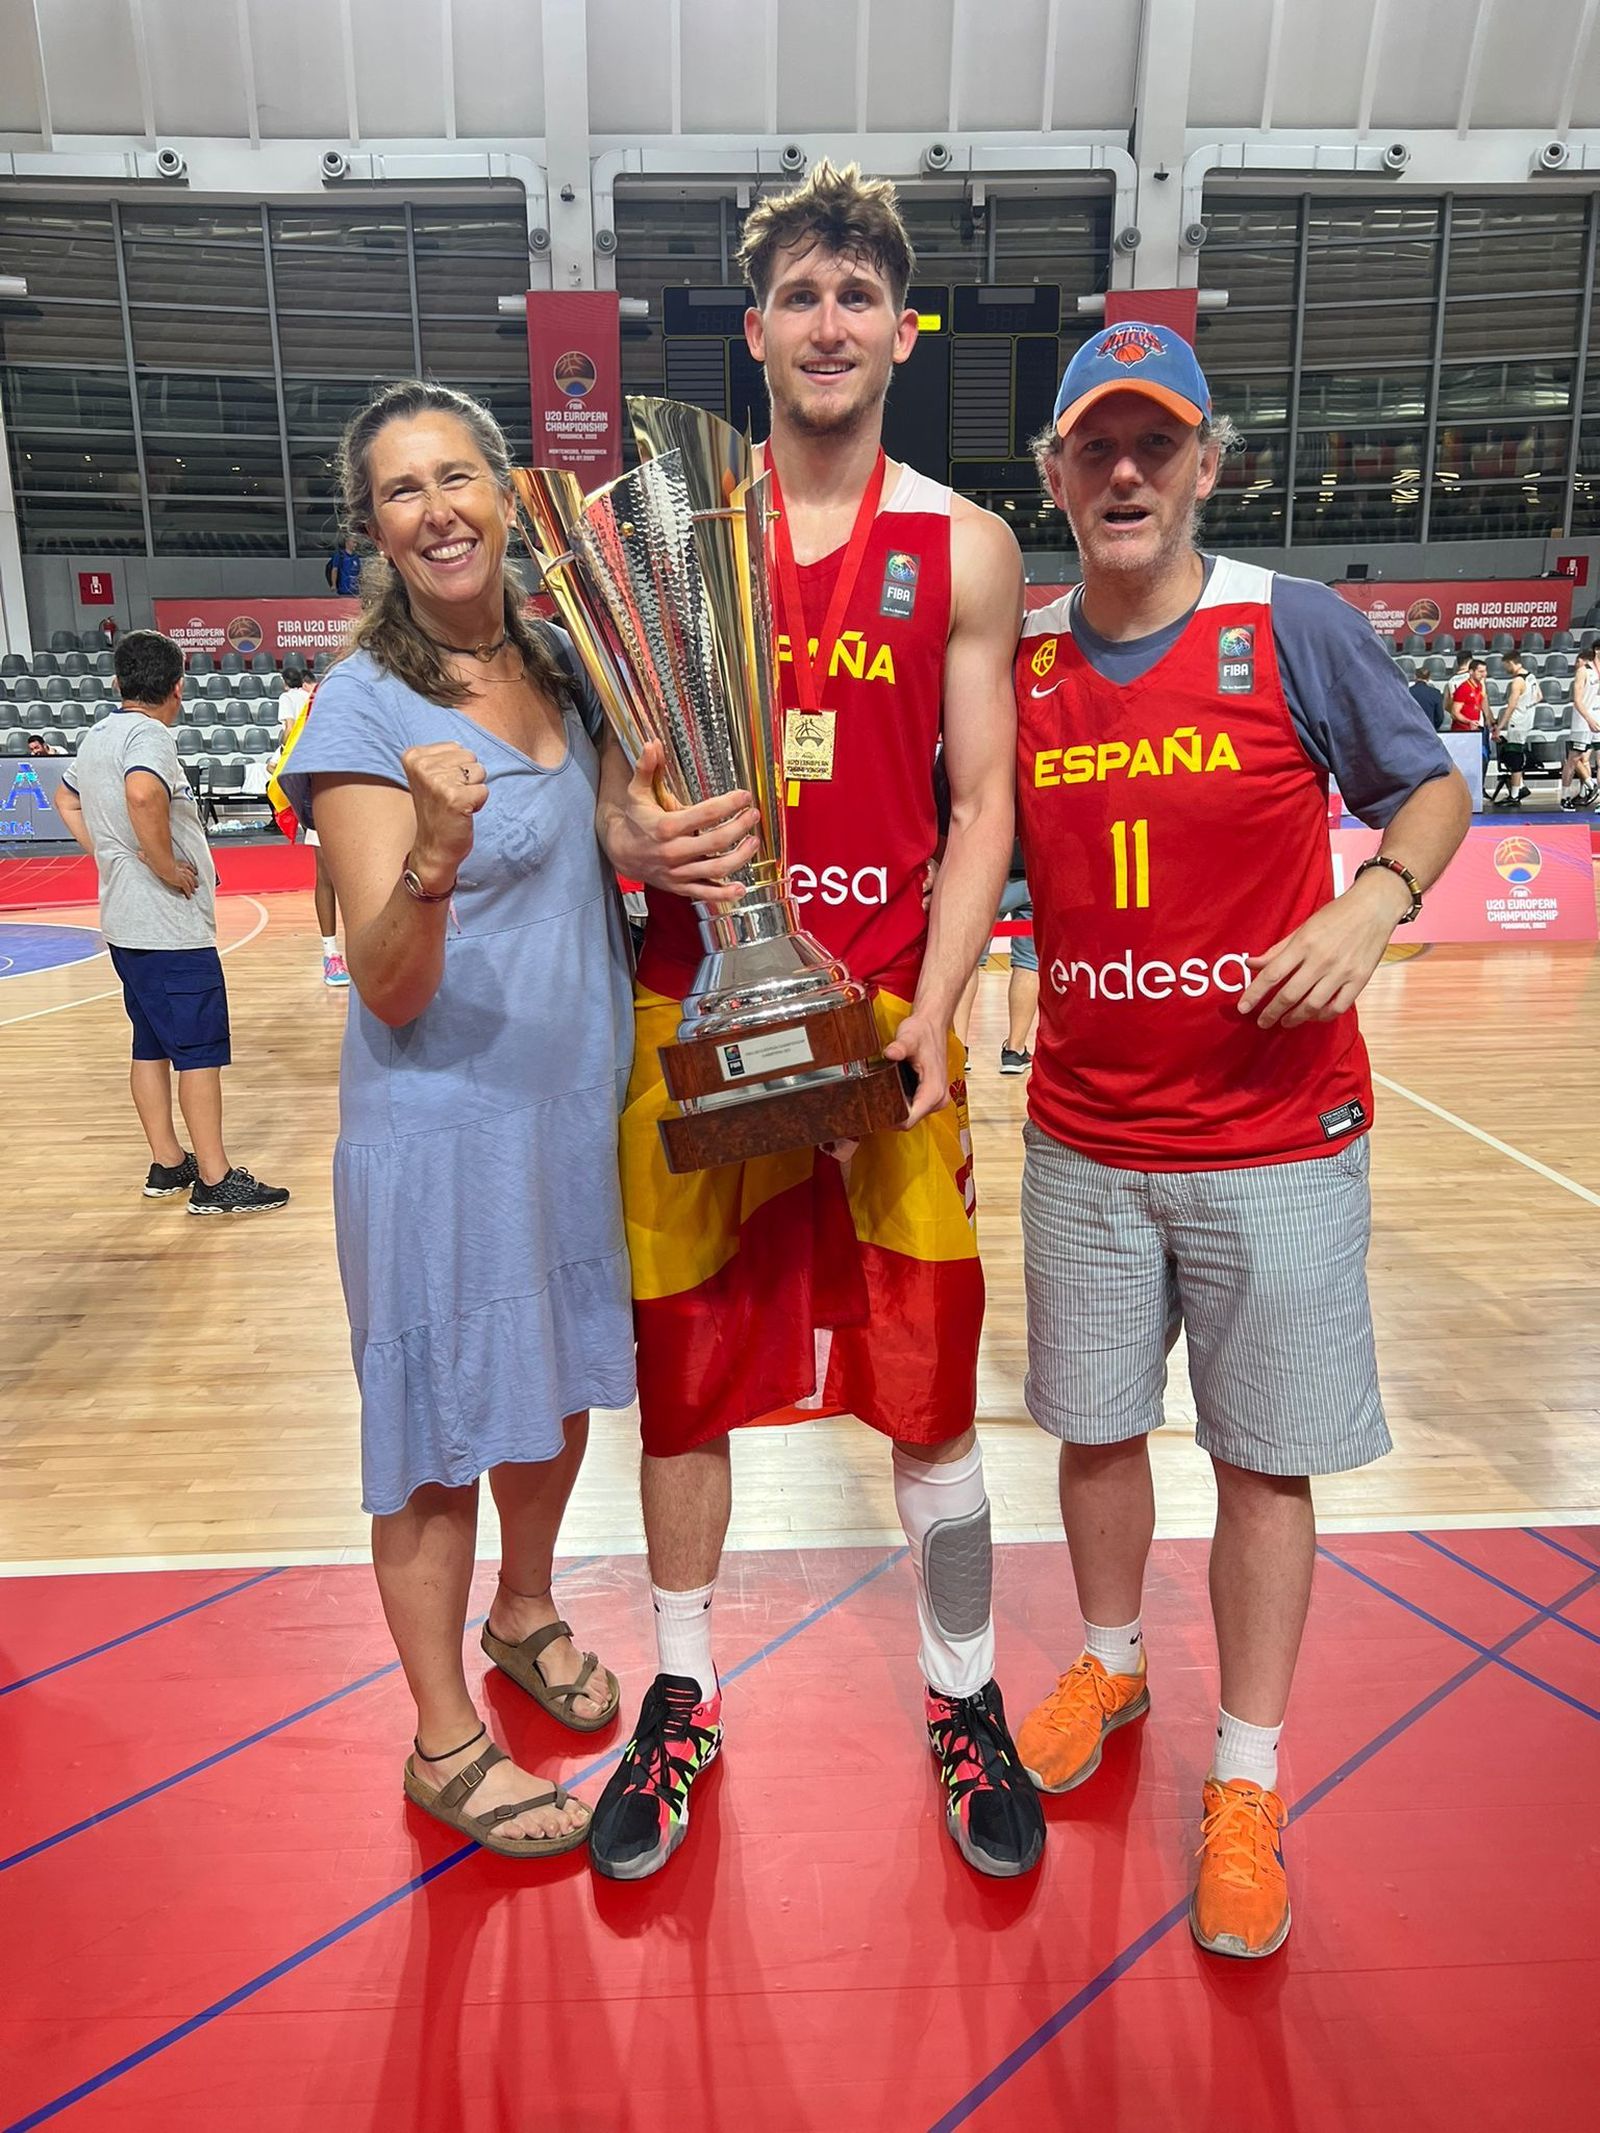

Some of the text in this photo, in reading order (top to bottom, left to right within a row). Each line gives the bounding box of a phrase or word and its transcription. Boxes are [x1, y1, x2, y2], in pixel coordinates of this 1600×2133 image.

[545, 411, 608, 421] U20 EUROPEAN
[545, 422, 608, 432] CHAMPIONSHIP
[886, 586, 911, 601] FIBA
[1456, 601, 1558, 615] FIBA U20 EUROPEAN
[277, 620, 302, 632] FIBA
[303, 620, 326, 632] U20
[1453, 615, 1558, 629] CHAMPIONSHIP 2022
[169, 628, 226, 637] U20 EUROPEAN
[1223, 663, 1249, 677] FIBA
[1034, 726, 1242, 788] ESPAÑA
[1110, 819, 1150, 909] 11
[1486, 898, 1557, 910] U20 EUROPEAN
[1487, 910, 1559, 921] CHAMPIONSHIP
[1050, 949, 1252, 1000] endesa
[1351, 1106, 1364, 1120] XL
